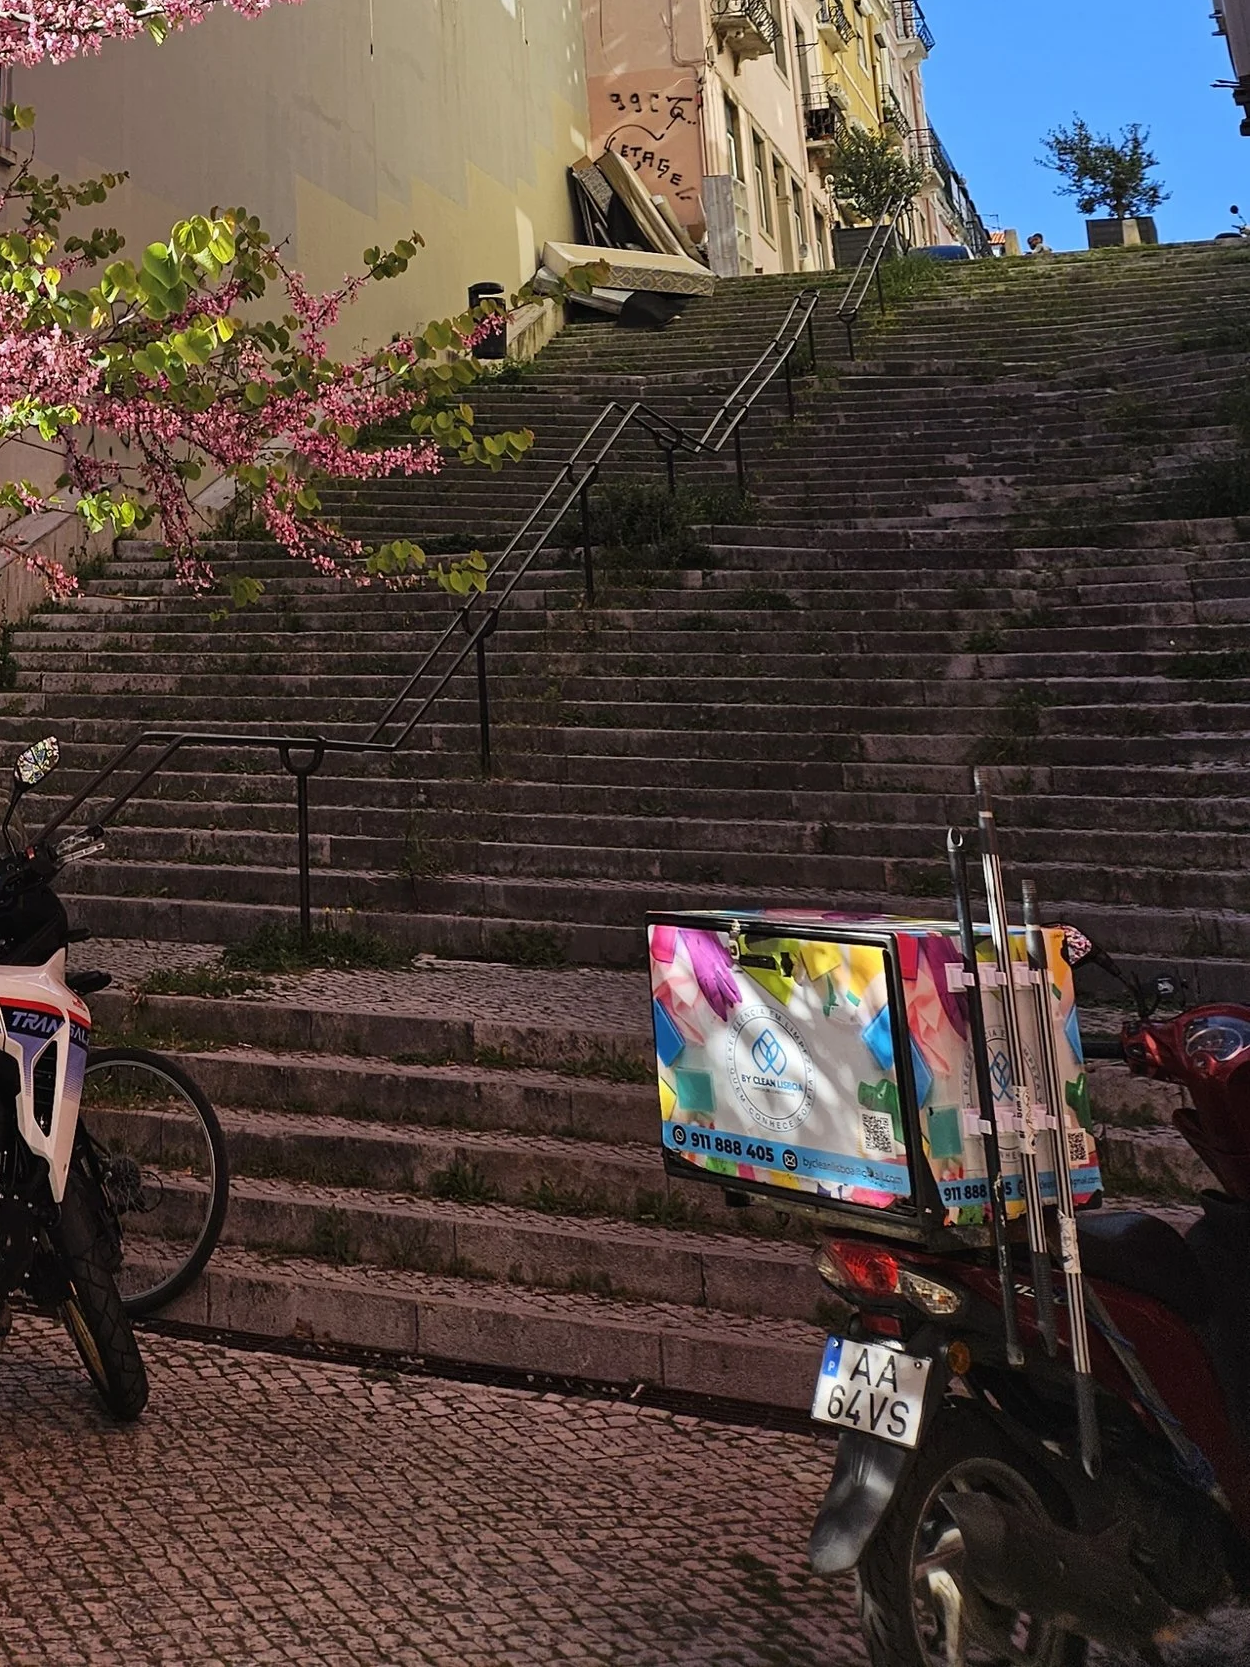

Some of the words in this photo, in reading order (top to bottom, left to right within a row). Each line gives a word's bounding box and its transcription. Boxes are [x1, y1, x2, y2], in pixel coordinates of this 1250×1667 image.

[741, 1074, 752, 1084] BY
[753, 1076, 776, 1088] CLEAN
[777, 1080, 803, 1092] LISBOA
[749, 1107, 794, 1130] CONHECE
[691, 1132, 711, 1150] 911
[715, 1137, 742, 1156] 888
[746, 1144, 774, 1163] 405
[944, 1187, 961, 1202] 911
[964, 1184, 988, 1199] 888
[850, 1348, 897, 1393] AA
[827, 1384, 909, 1437] 64VS
